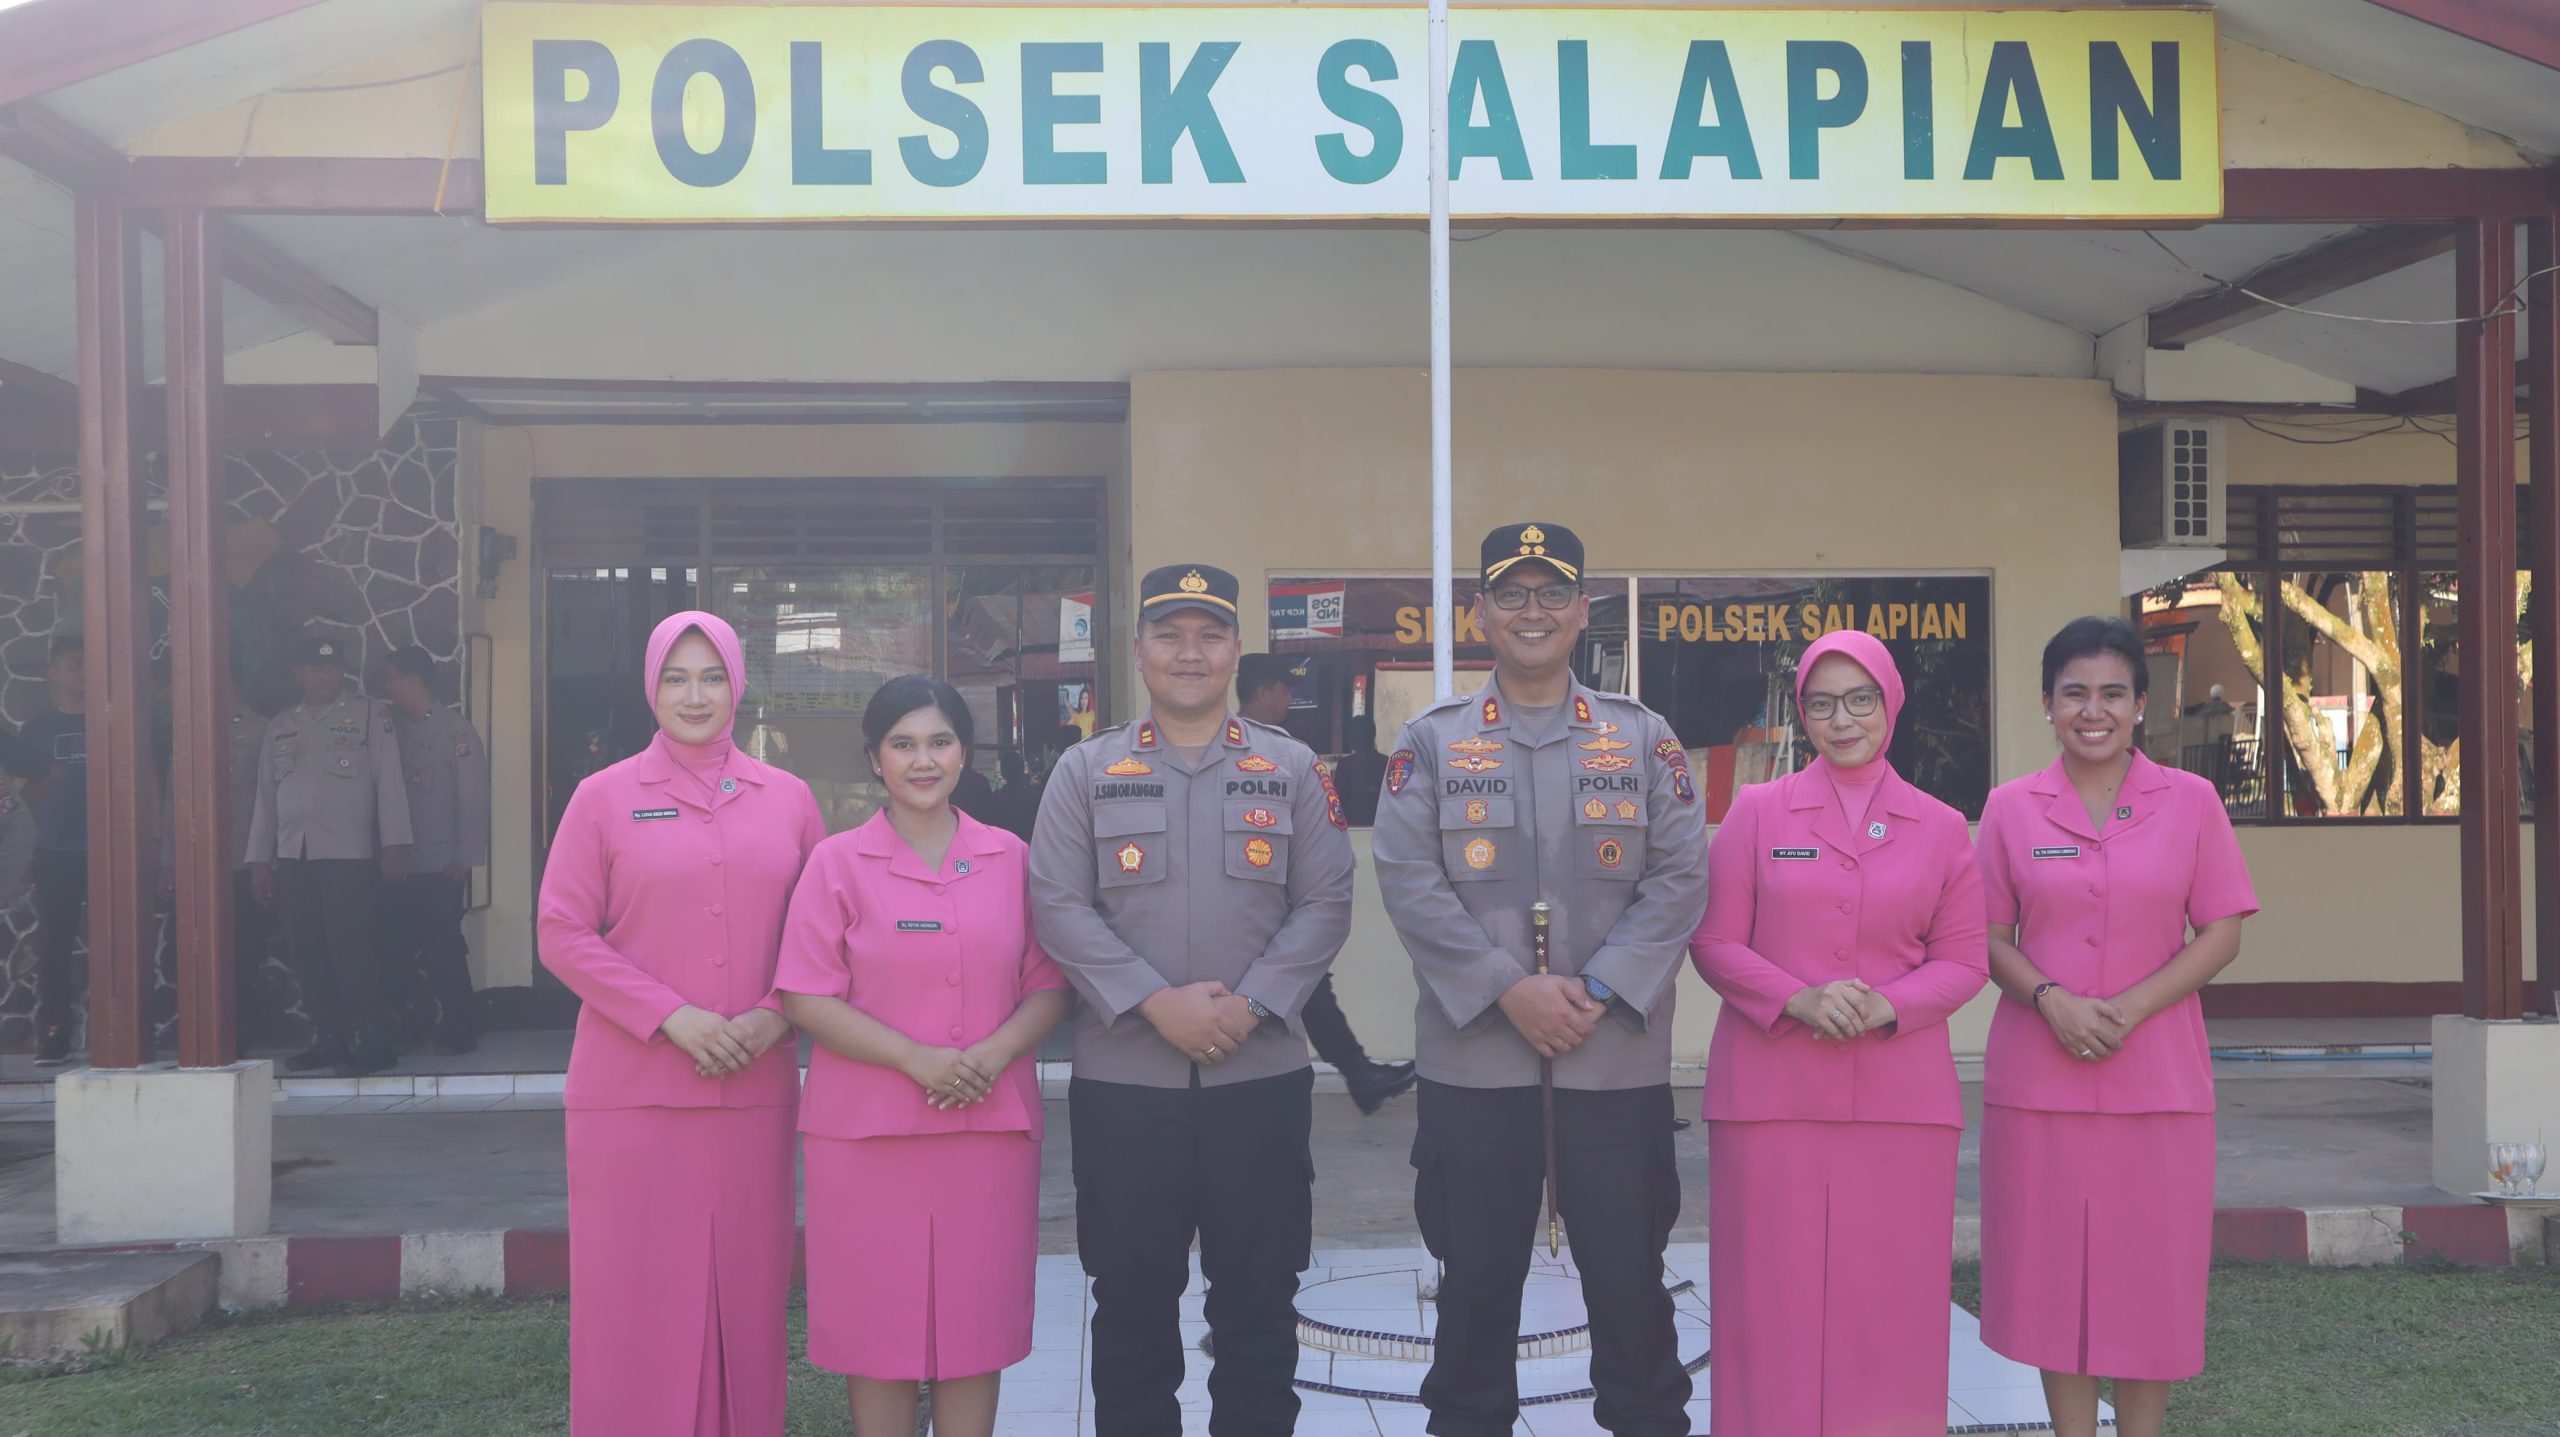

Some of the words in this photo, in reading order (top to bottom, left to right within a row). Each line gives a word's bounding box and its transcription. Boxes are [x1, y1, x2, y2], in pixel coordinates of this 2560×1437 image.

[531, 38, 1247, 187] POLSEK
[1314, 38, 2182, 186] SALAPIAN
[1658, 604, 1792, 642] POLSEK
[1226, 780, 1288, 798] POLRI
[1446, 778, 1508, 795] DAVID
[1578, 775, 1639, 793] POLRI
